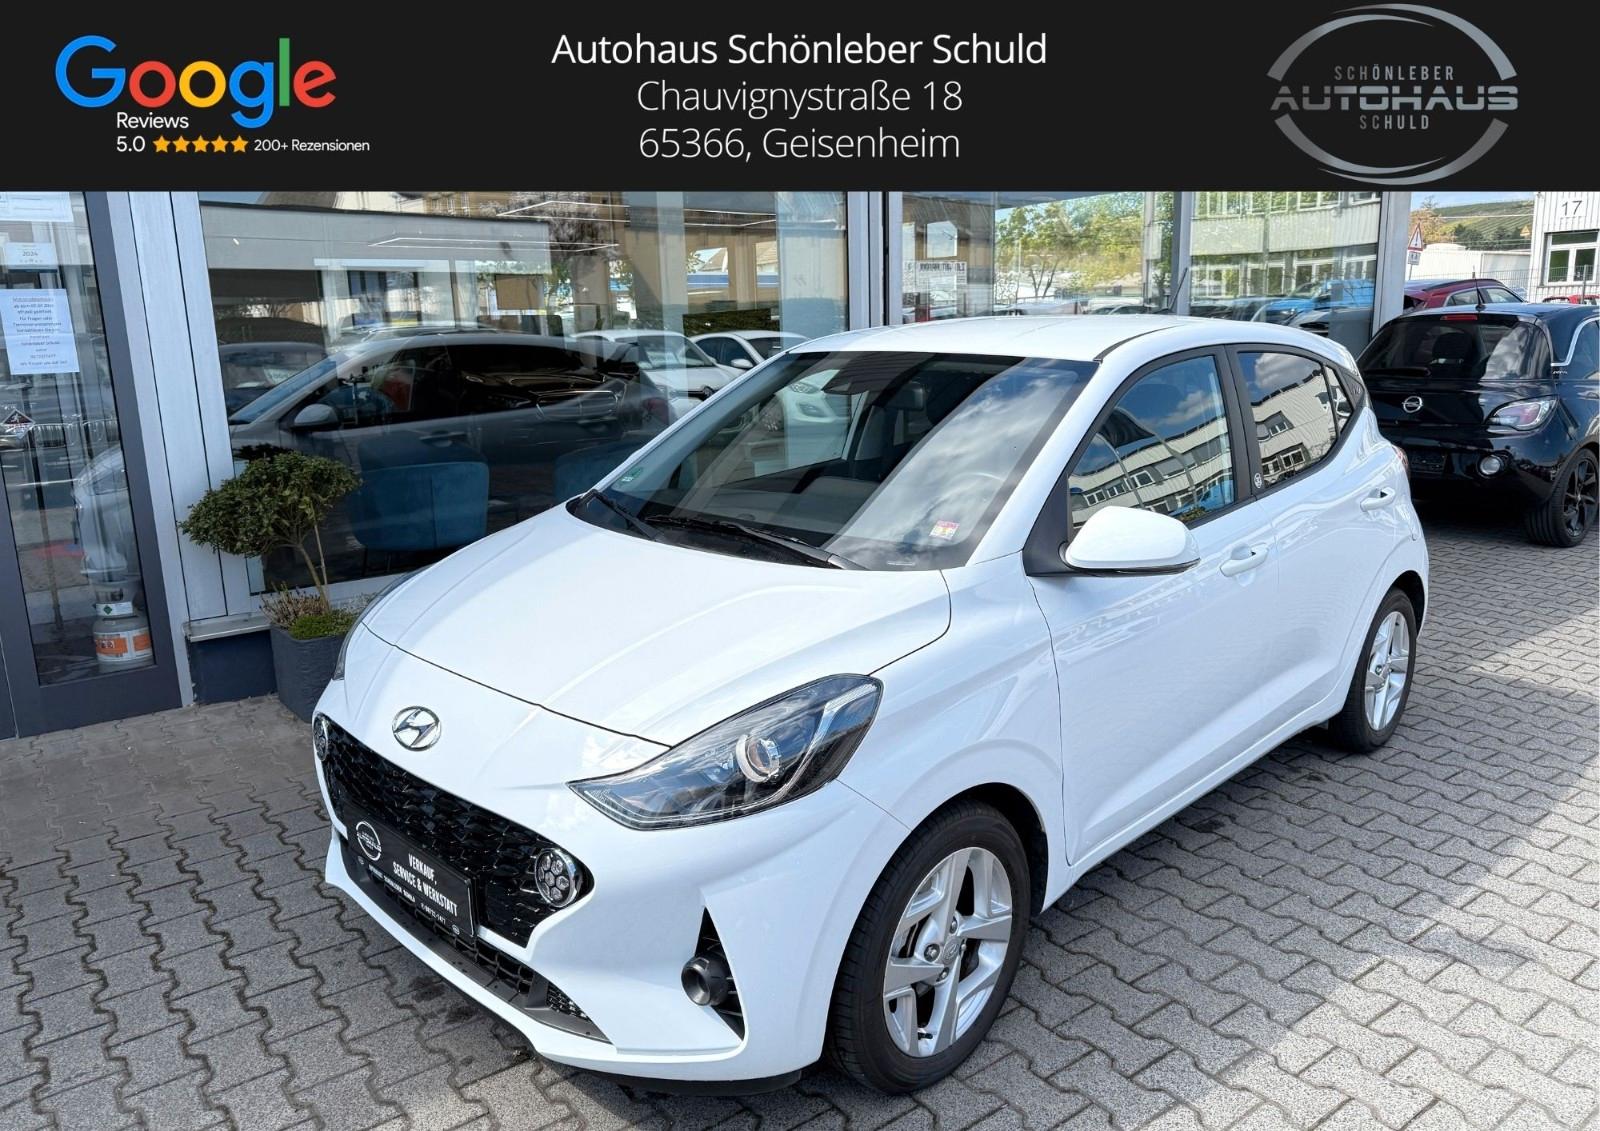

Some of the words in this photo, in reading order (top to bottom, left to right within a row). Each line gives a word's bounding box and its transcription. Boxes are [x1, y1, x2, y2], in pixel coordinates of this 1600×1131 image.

[1561, 200, 1583, 216] 17
[393, 861, 417, 888] SERVICE
[417, 878, 423, 892] &
[422, 881, 458, 917] WERKSTATT
